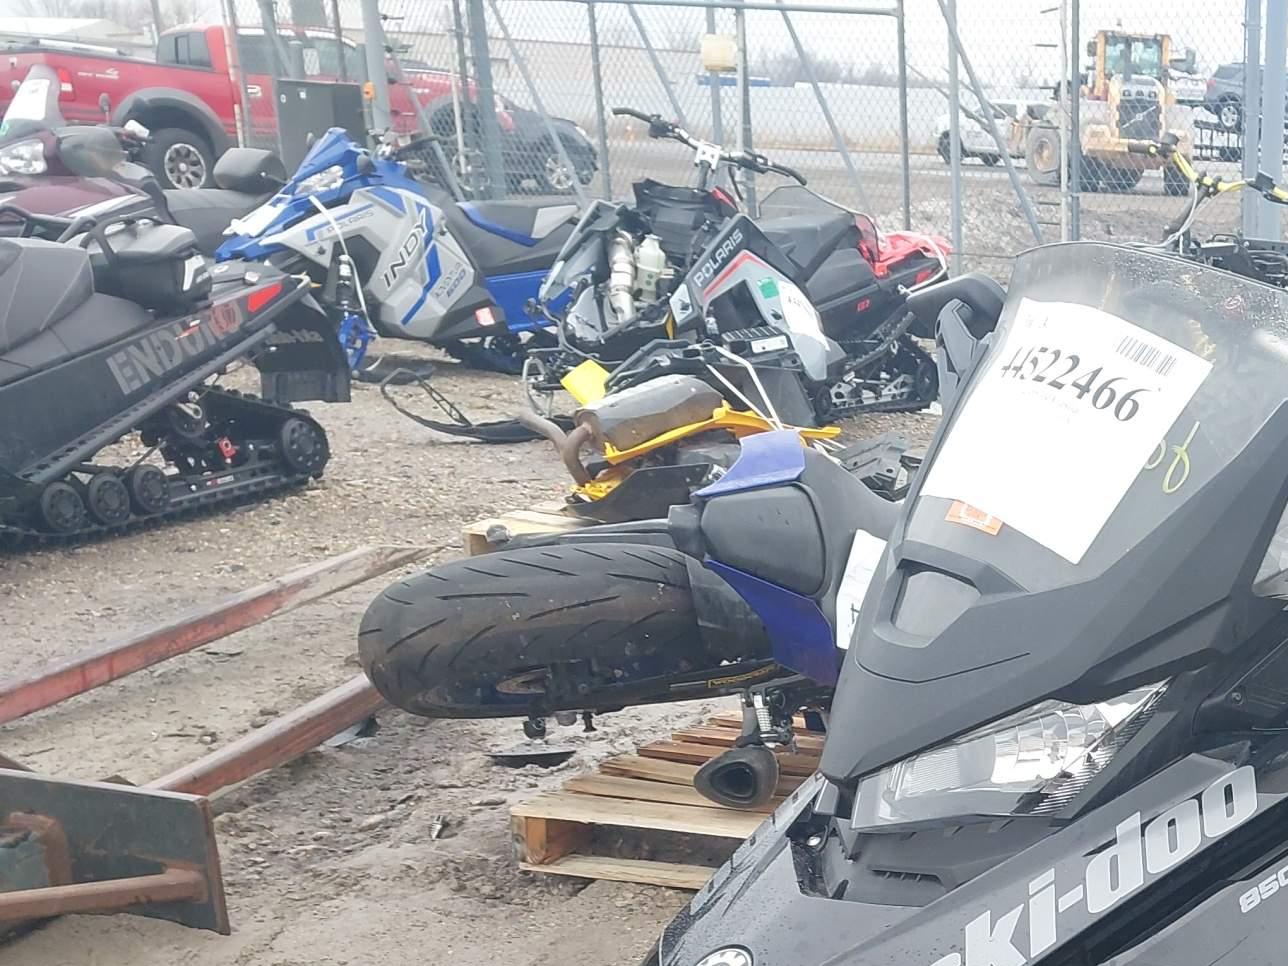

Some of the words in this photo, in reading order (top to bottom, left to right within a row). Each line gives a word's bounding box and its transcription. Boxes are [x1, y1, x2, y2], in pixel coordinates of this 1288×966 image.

[381, 207, 428, 288] INDY
[693, 228, 743, 287] POLARIS
[1001, 346, 1152, 422] 44522466
